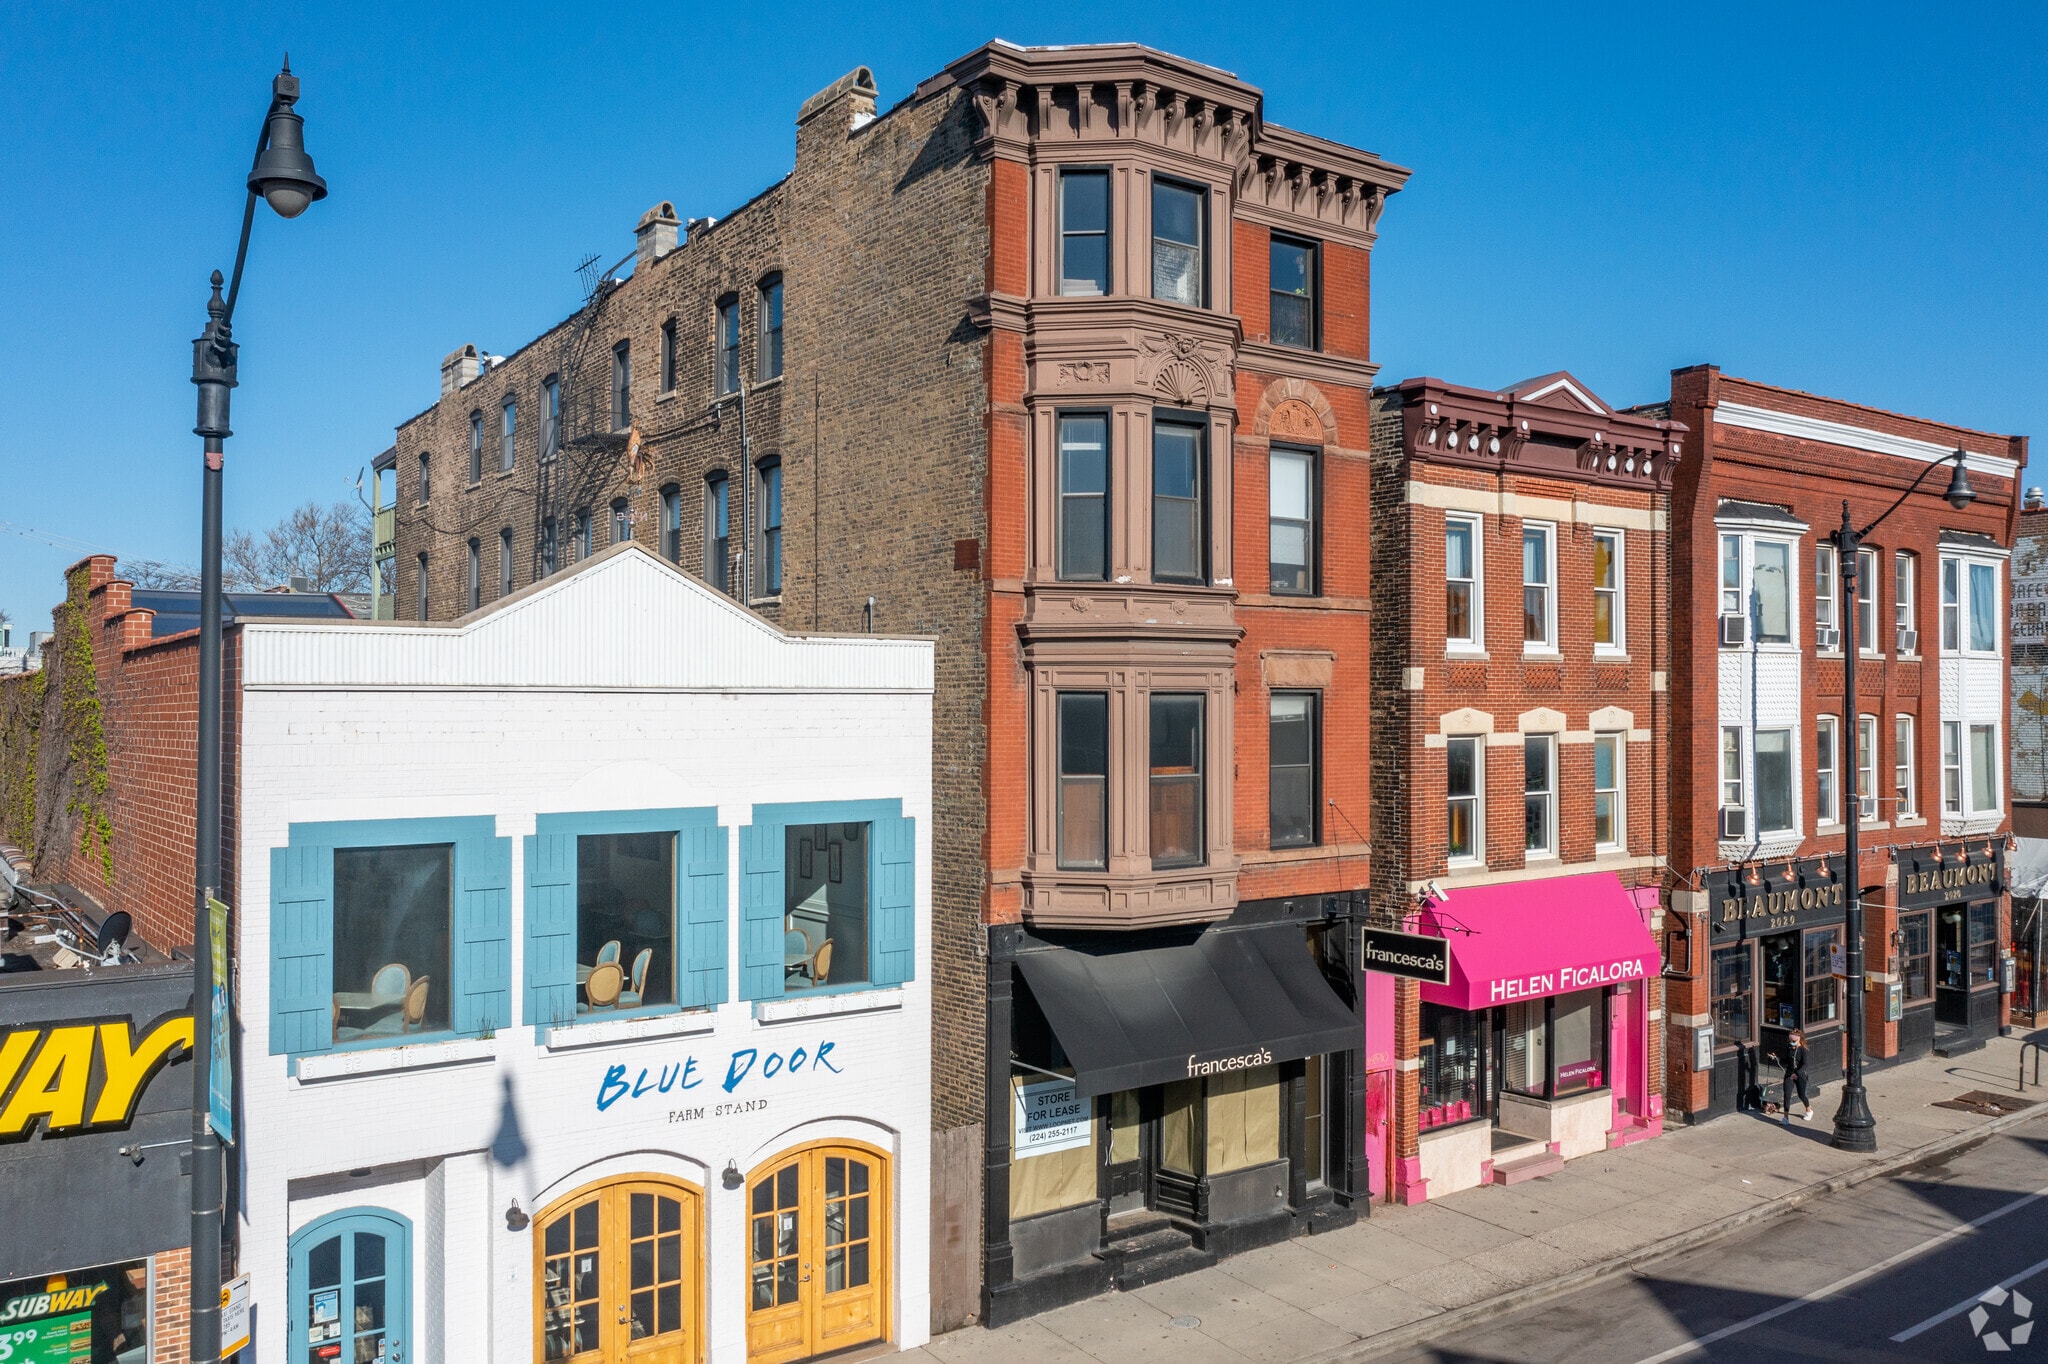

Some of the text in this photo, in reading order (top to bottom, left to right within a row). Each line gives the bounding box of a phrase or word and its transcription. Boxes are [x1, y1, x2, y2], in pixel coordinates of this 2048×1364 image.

[1904, 863, 1997, 894] BEAUMONT
[1944, 889, 1961, 901] 2020
[1771, 915, 1795, 929] 2020
[1366, 941, 1444, 971] francesca's
[1491, 959, 1643, 1001] HELEN FICALORA
[1187, 1047, 1272, 1077] francesca's
[597, 1040, 844, 1112] BLUE DOOR
[668, 1099, 768, 1124] FARM STAND
[1038, 1091, 1070, 1106] STORE
[1027, 1104, 1080, 1122] FOR LEASE
[1029, 1126, 1077, 1143] (224) 255-2117
[0, 1284, 108, 1321] SUBWAY
